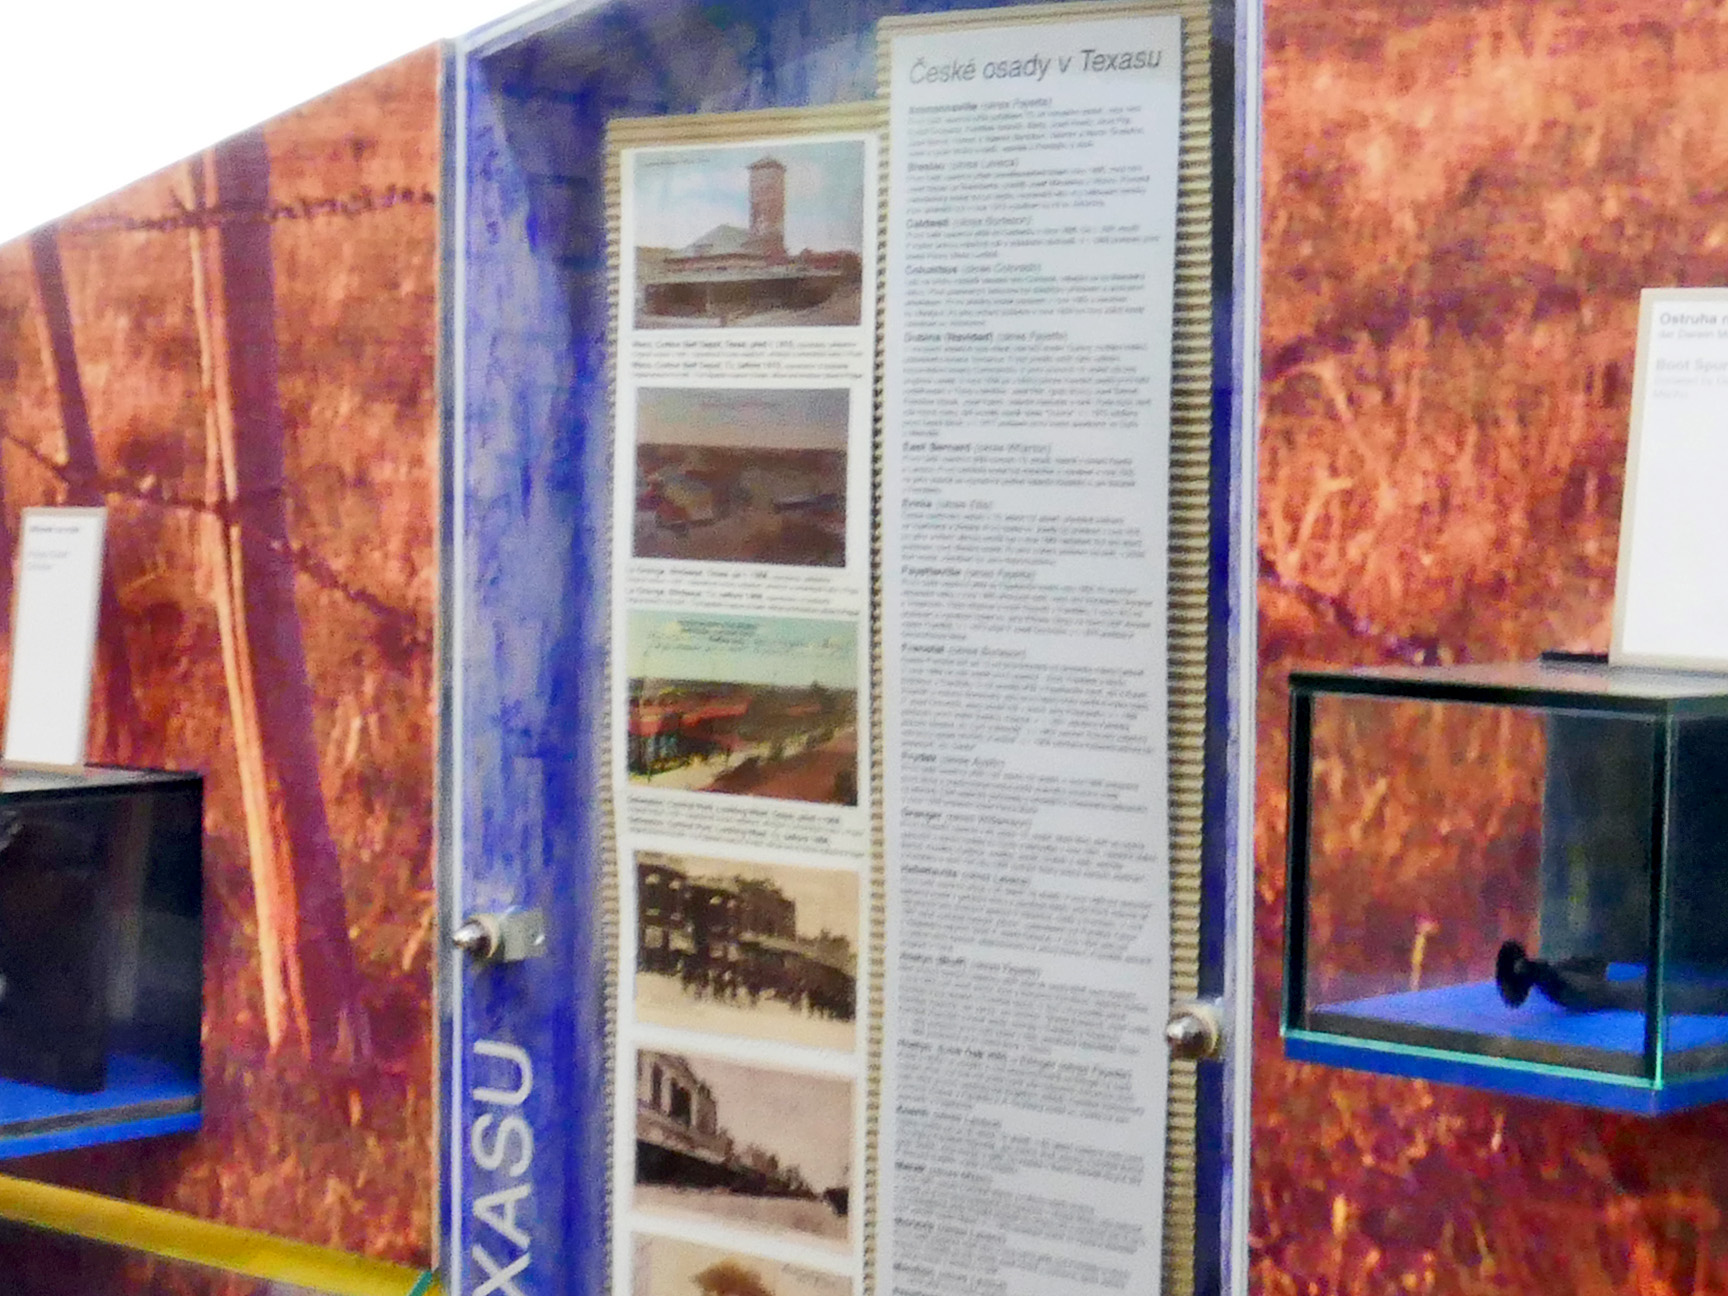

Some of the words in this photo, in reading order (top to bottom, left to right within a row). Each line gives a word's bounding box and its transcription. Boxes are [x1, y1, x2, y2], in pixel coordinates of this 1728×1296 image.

[909, 58, 976, 85] České
[983, 55, 1052, 82] osady
[1059, 57, 1072, 74] v
[1080, 49, 1162, 73] Texasu
[1659, 311, 1718, 326] Ostruha
